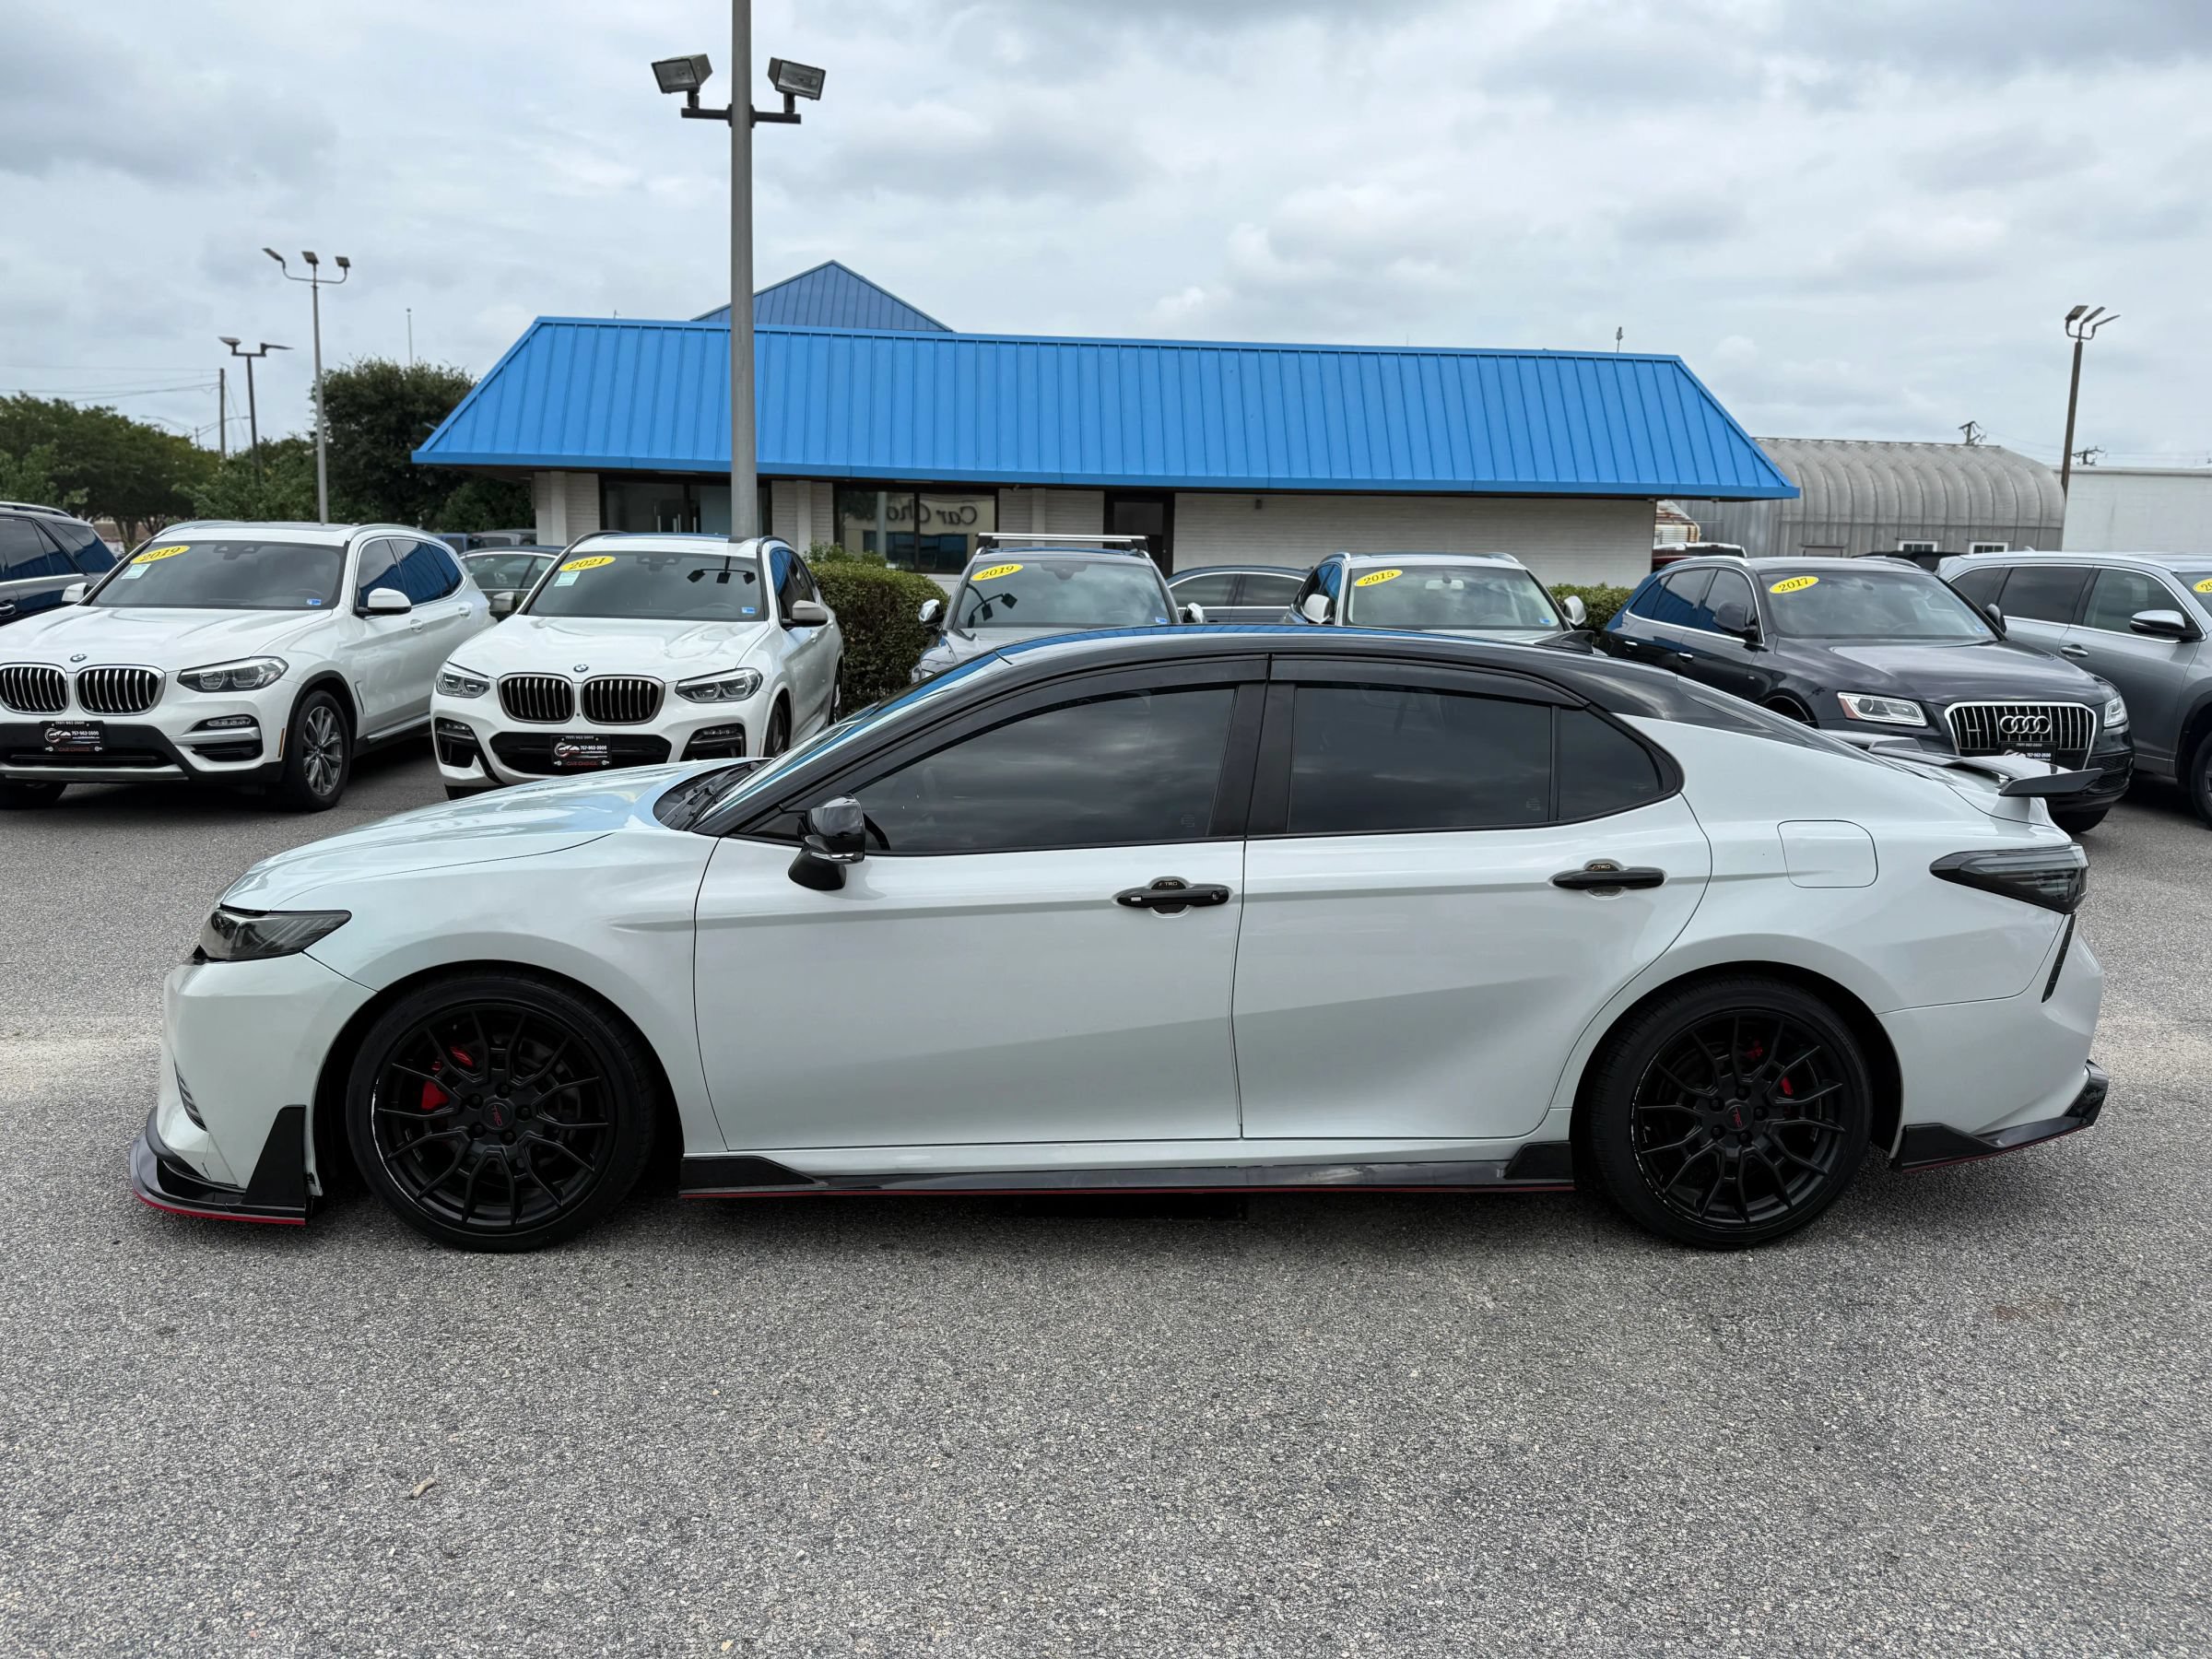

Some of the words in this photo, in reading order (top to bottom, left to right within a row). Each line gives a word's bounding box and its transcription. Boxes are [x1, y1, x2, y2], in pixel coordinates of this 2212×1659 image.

[140, 547, 181, 561] 2019
[569, 557, 606, 570] 2021
[981, 565, 1014, 579] 2019
[1364, 571, 1394, 584] 2015
[1779, 578, 1808, 591] 2017
